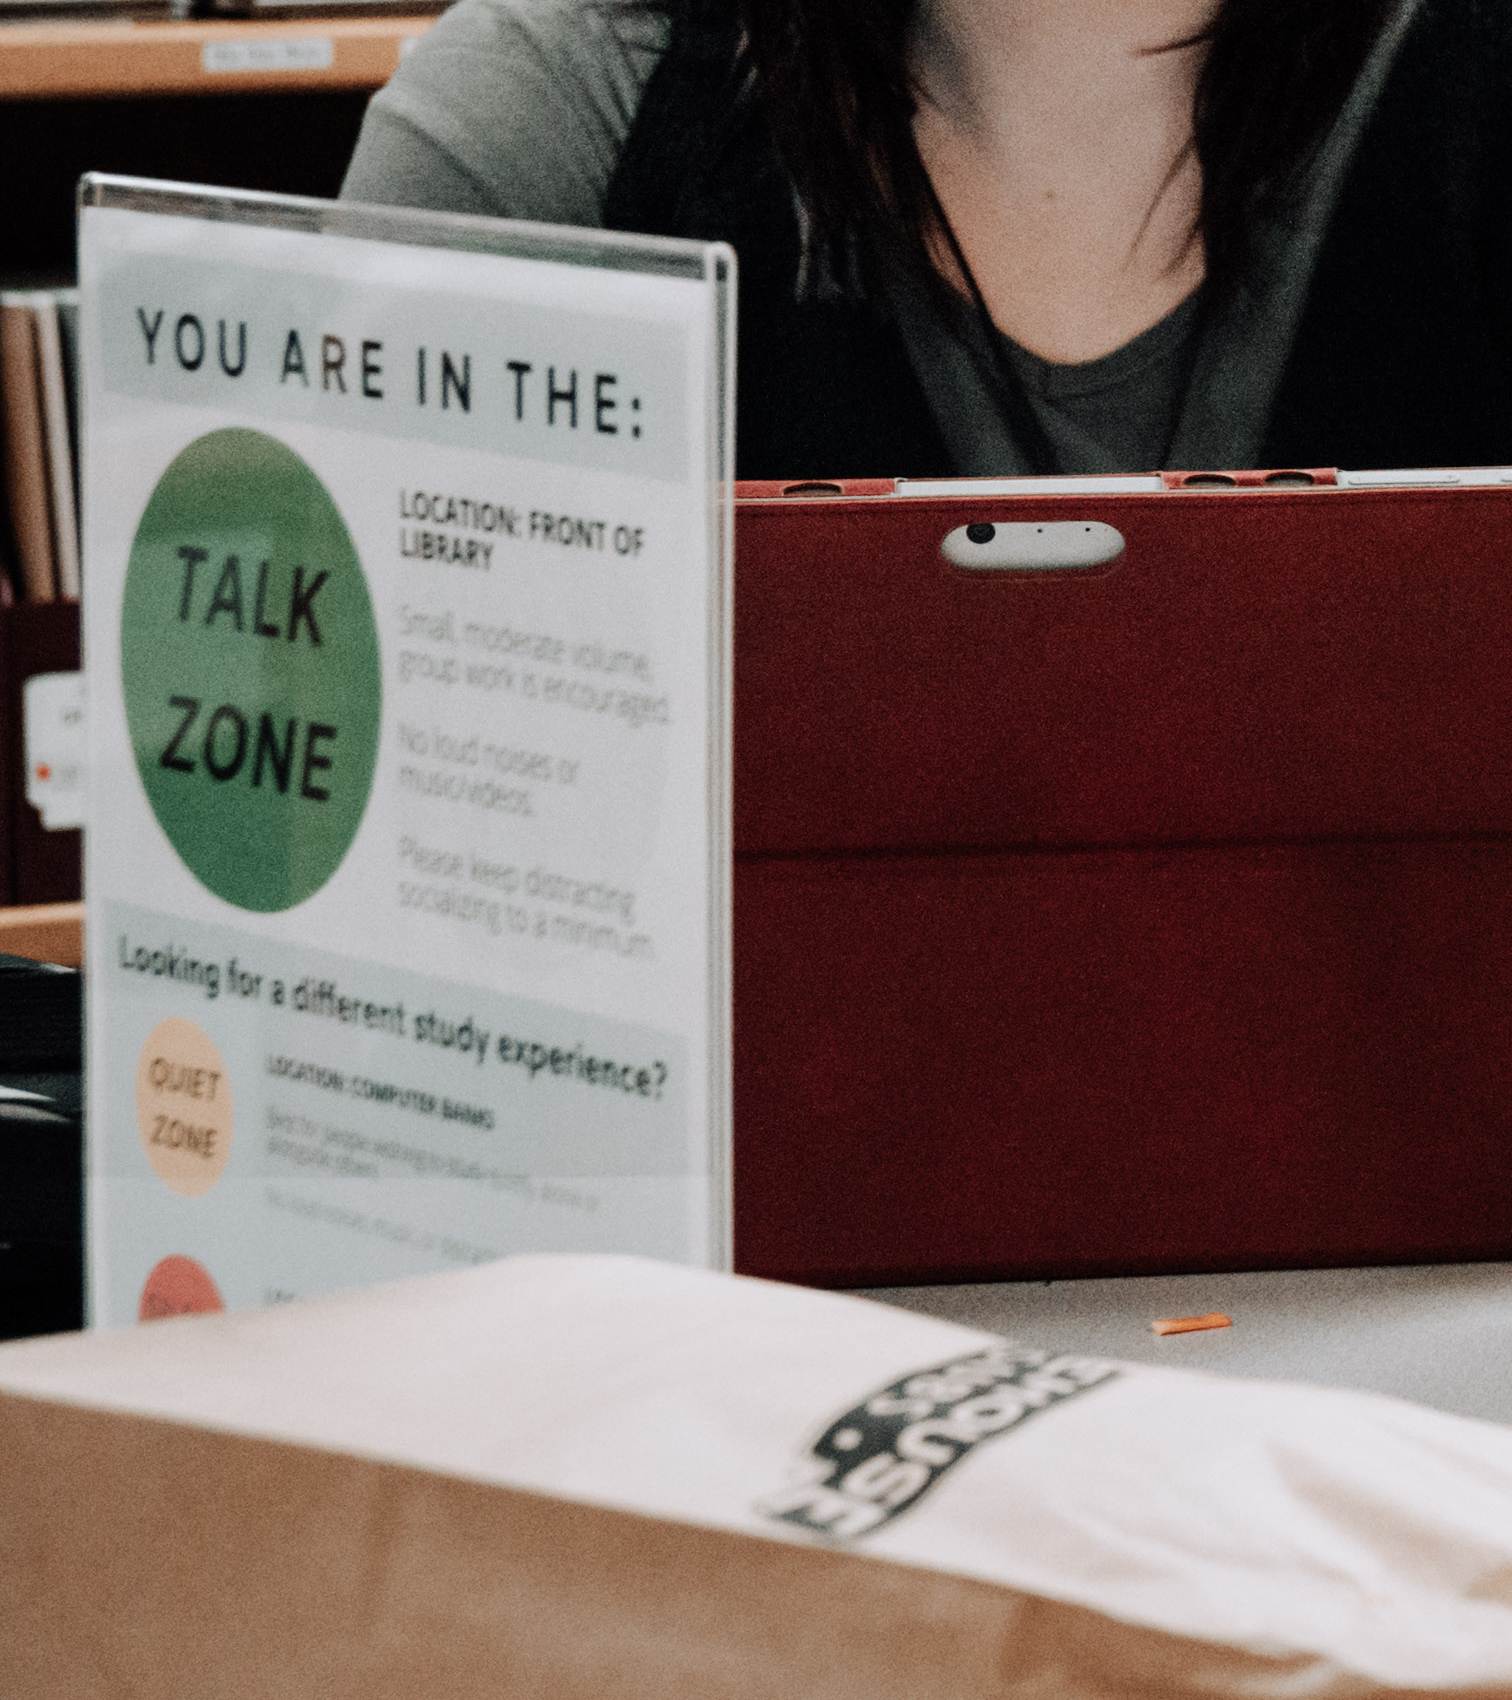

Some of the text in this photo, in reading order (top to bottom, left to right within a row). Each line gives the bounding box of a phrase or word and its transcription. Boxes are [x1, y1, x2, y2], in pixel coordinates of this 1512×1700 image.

[137, 307, 641, 438] YOU ARE IN THE:
[400, 489, 645, 557] LOCATION: FRONT OF
[400, 527, 493, 572] LIBRARY
[177, 546, 331, 647] TALK
[160, 695, 338, 801] ZONE
[118, 934, 668, 1100] Looking for a different study experience?
[149, 1057, 221, 1101] QUIET
[151, 1114, 218, 1160] ZONE
